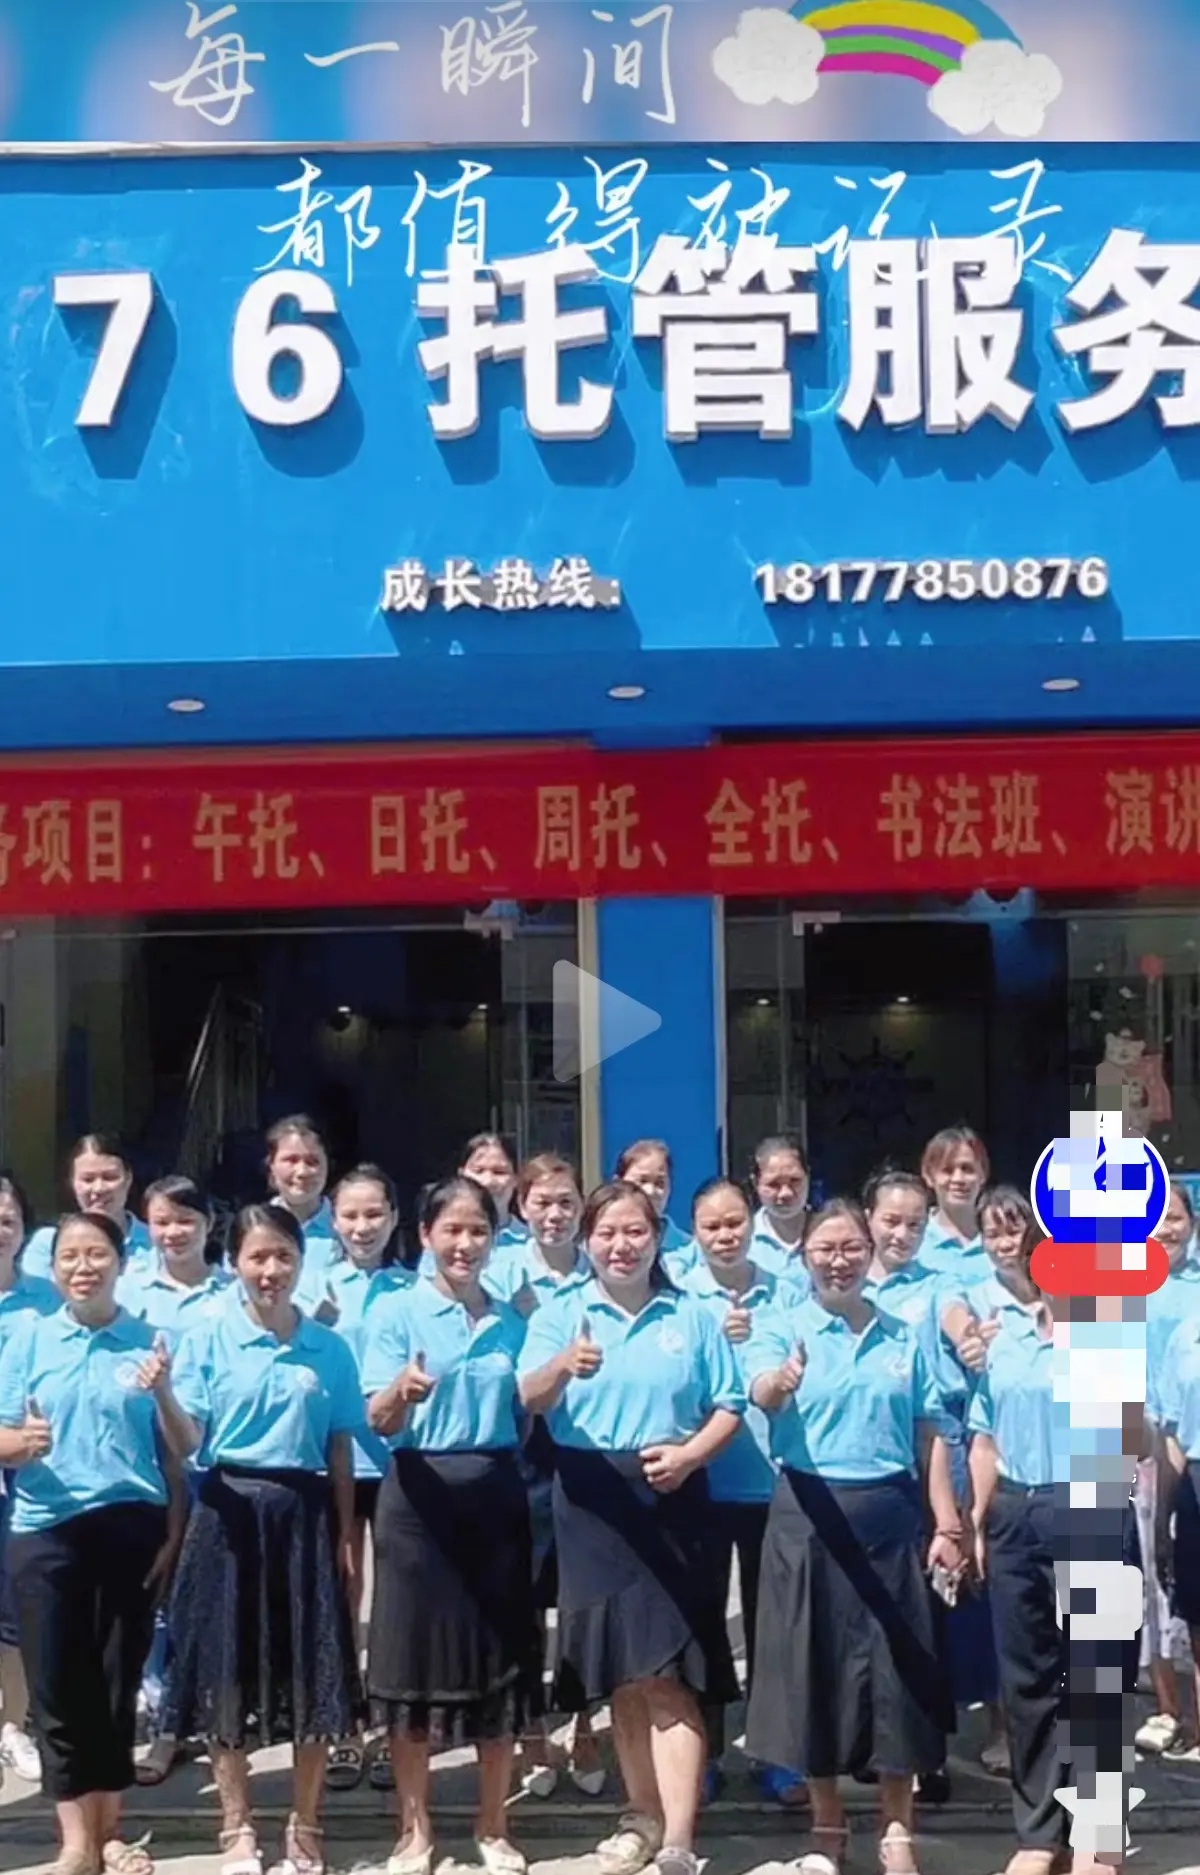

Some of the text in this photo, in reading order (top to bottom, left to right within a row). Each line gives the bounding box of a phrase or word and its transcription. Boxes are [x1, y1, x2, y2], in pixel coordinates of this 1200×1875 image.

[380, 556, 1109, 612] 成长热线: 18177850876
